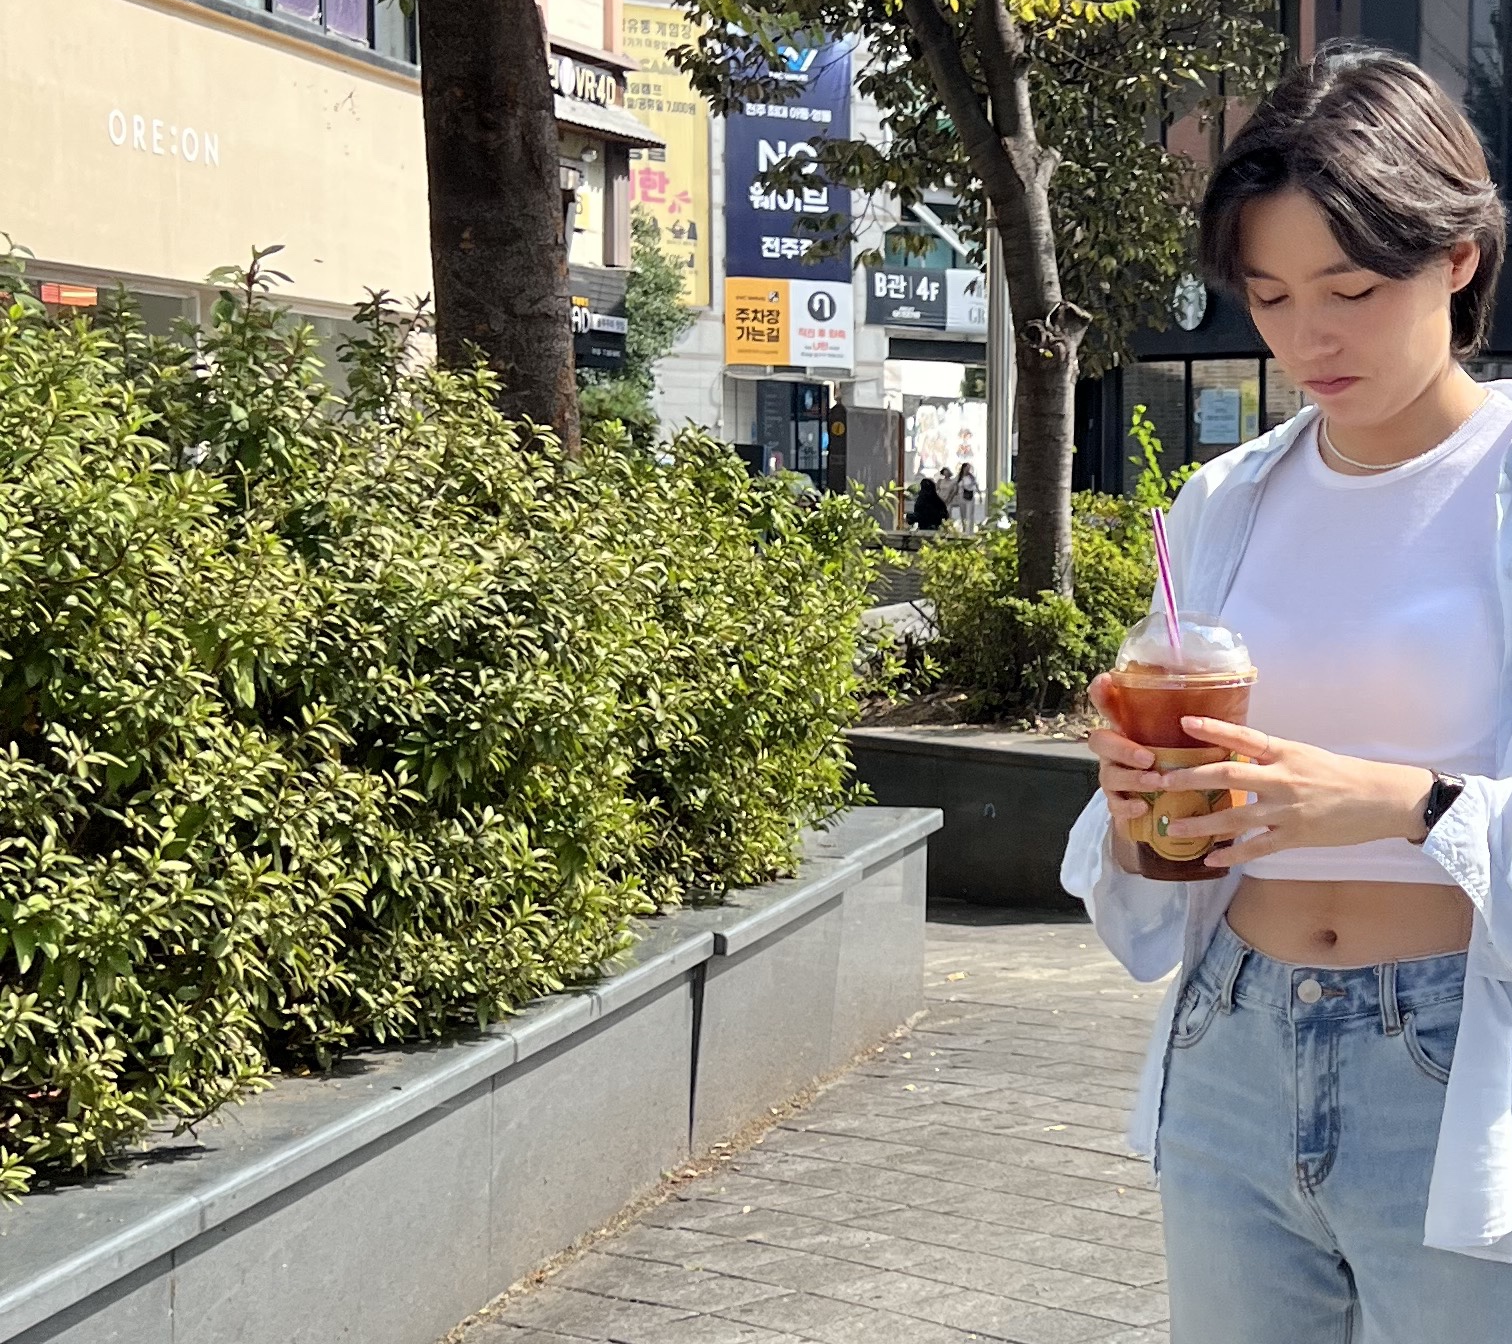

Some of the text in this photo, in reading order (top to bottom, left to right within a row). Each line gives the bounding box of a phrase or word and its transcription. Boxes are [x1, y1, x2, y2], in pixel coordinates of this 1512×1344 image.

[874, 272, 940, 302] B관 4F
[735, 307, 780, 325] 주차장
[735, 326, 780, 343] 가는길
